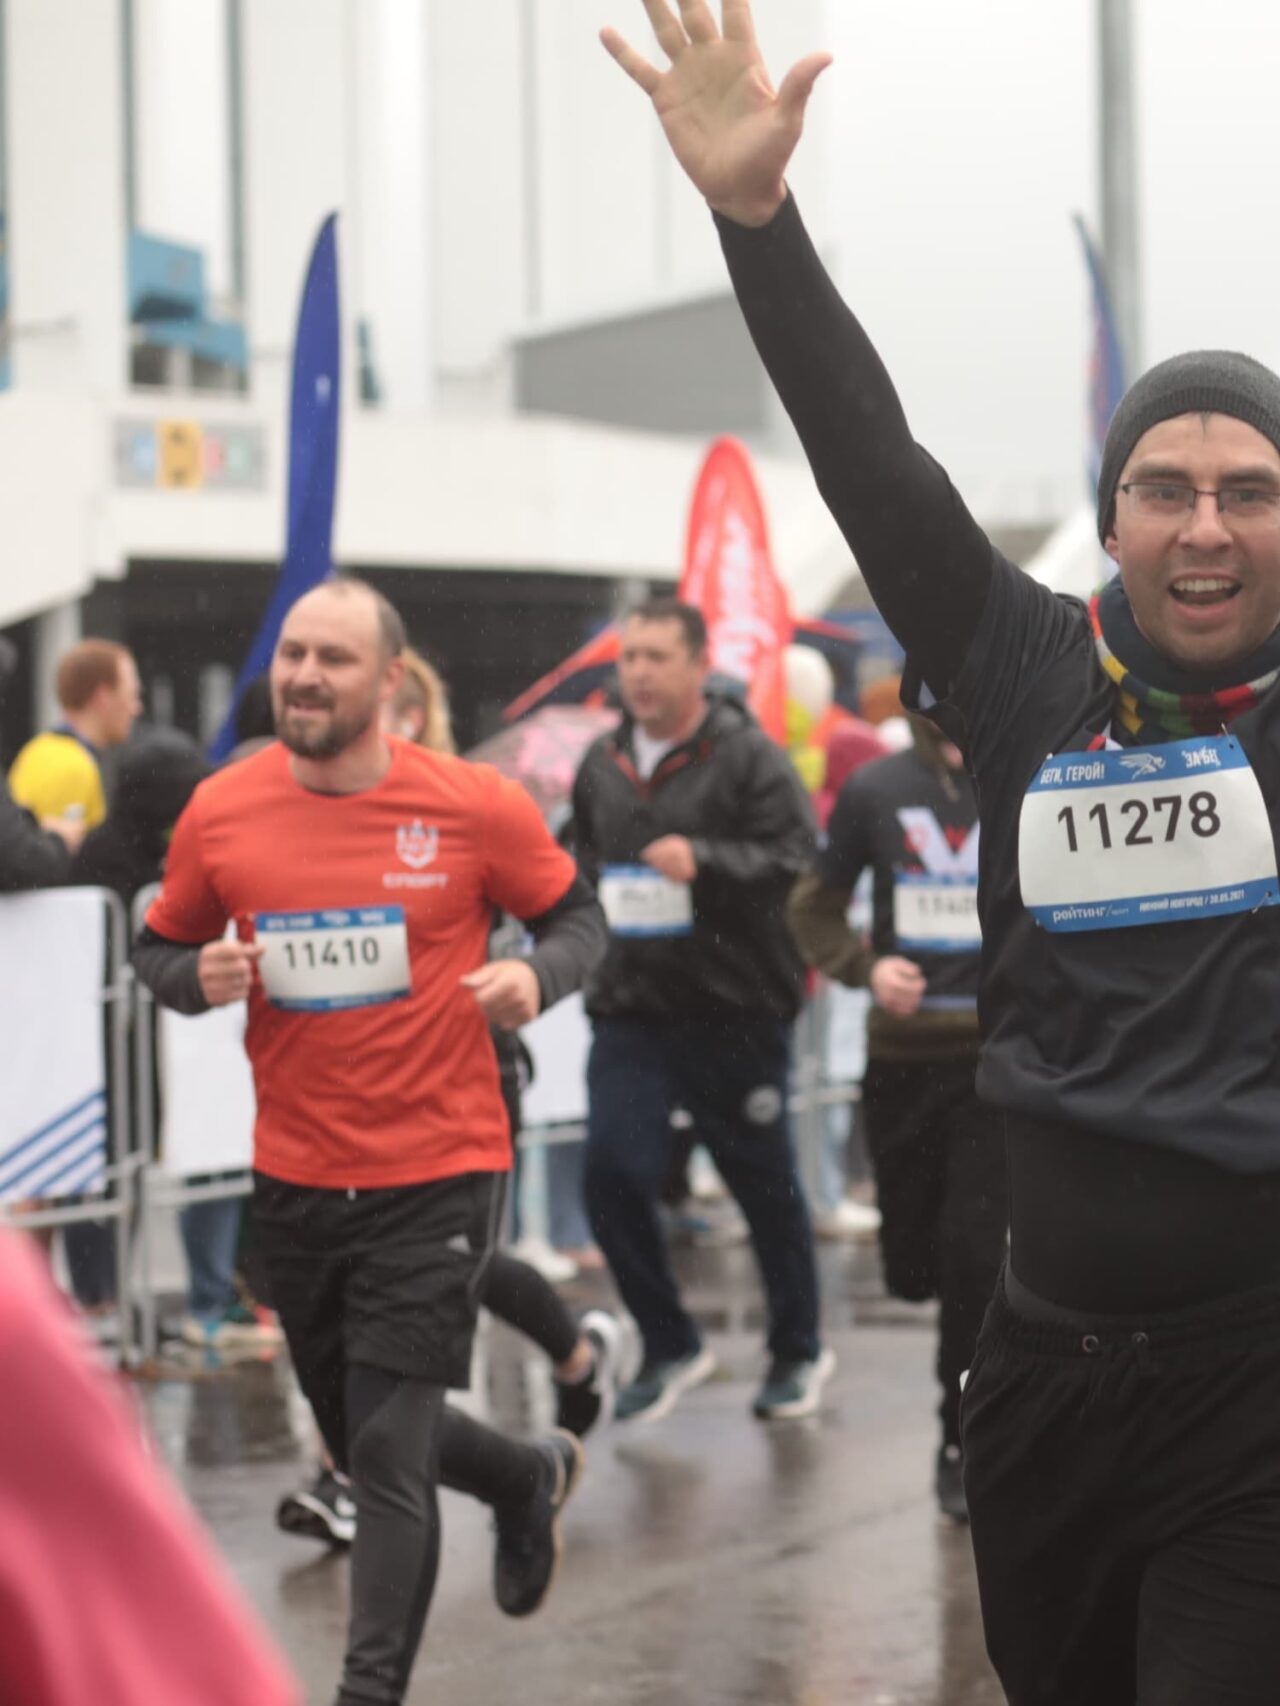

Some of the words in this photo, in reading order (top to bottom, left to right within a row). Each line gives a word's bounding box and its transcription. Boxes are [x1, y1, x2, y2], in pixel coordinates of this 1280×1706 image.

[1066, 761, 1105, 782] ГЕРОЙ!
[1057, 791, 1221, 852] 11278
[284, 936, 379, 968] 11410
